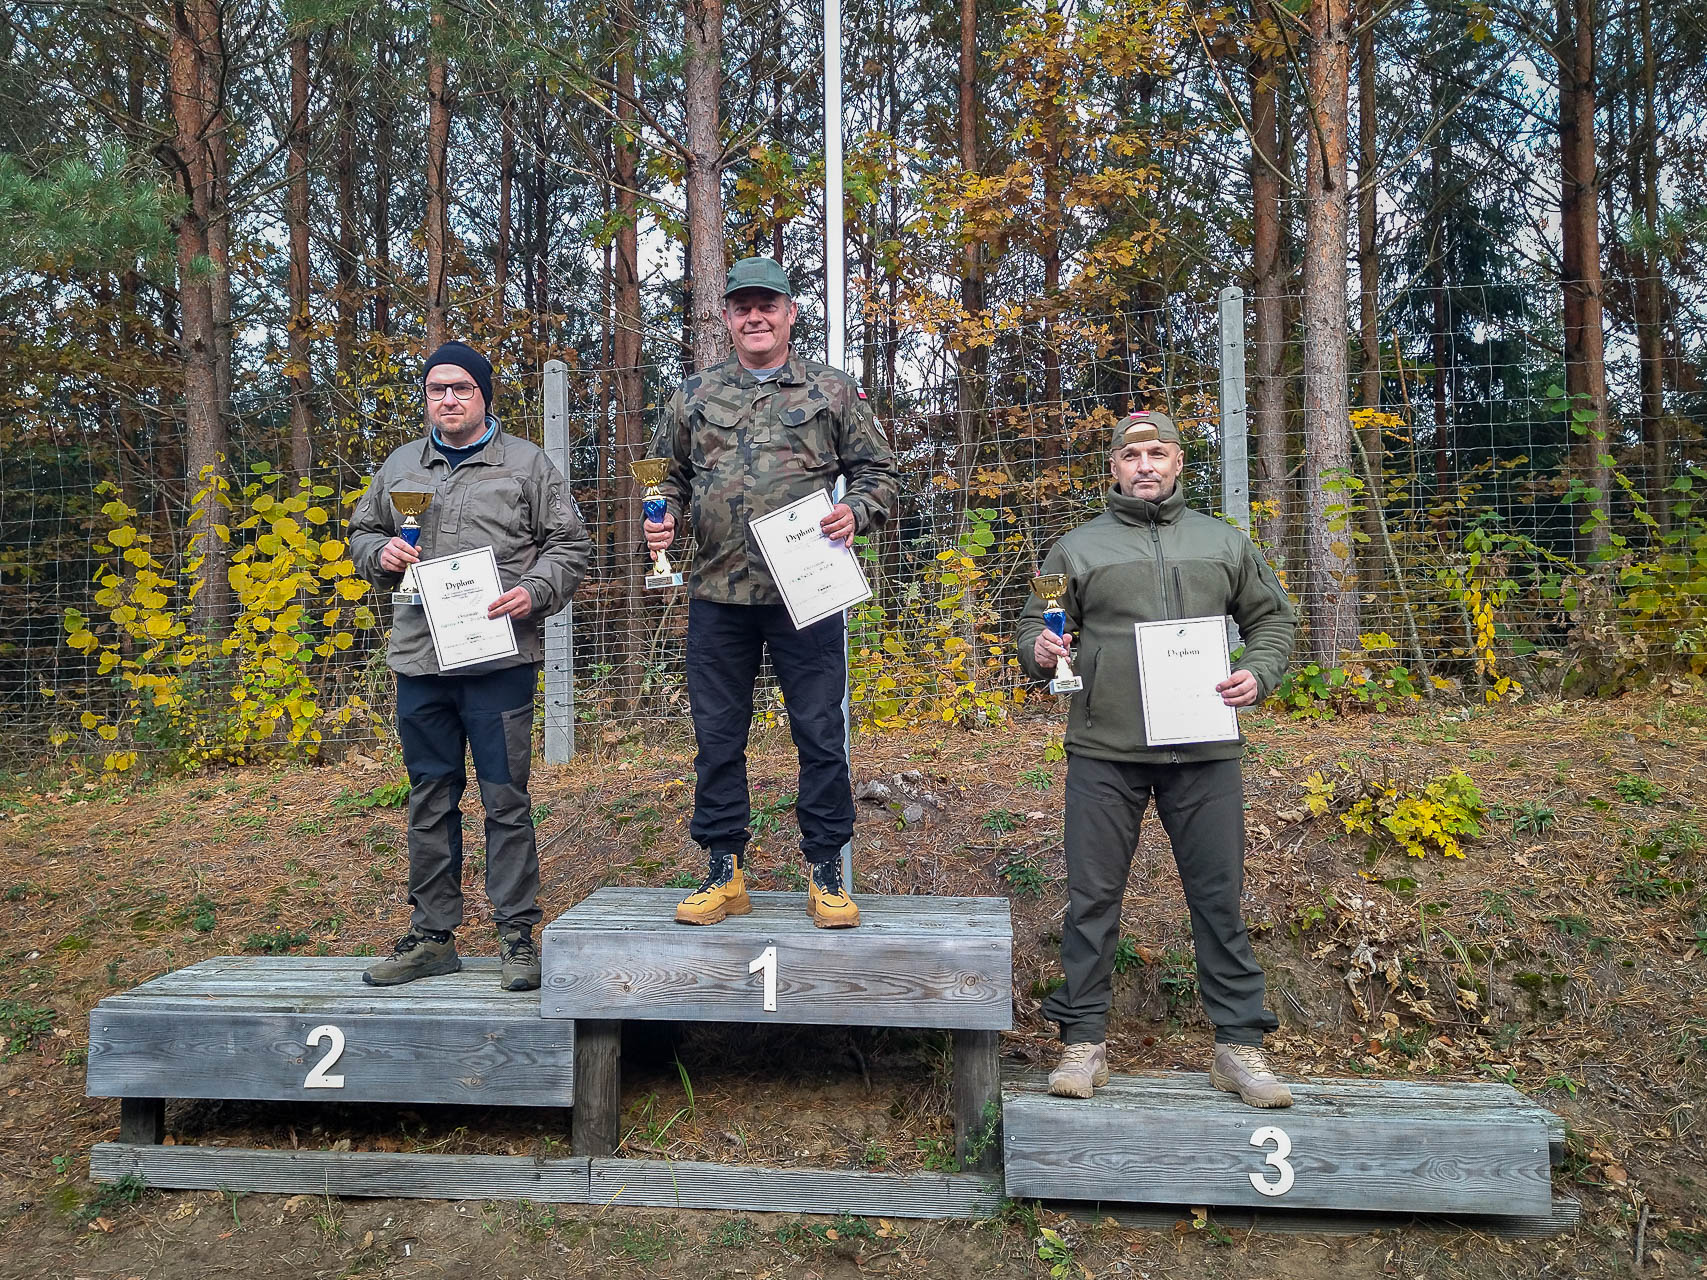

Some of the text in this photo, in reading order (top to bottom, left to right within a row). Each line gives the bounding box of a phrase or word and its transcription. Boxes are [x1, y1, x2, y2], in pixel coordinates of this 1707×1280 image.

[445, 578, 475, 591] Dyplom
[748, 946, 778, 1012] 1
[303, 1024, 345, 1088] 2
[1248, 1125, 1295, 1196] 3
